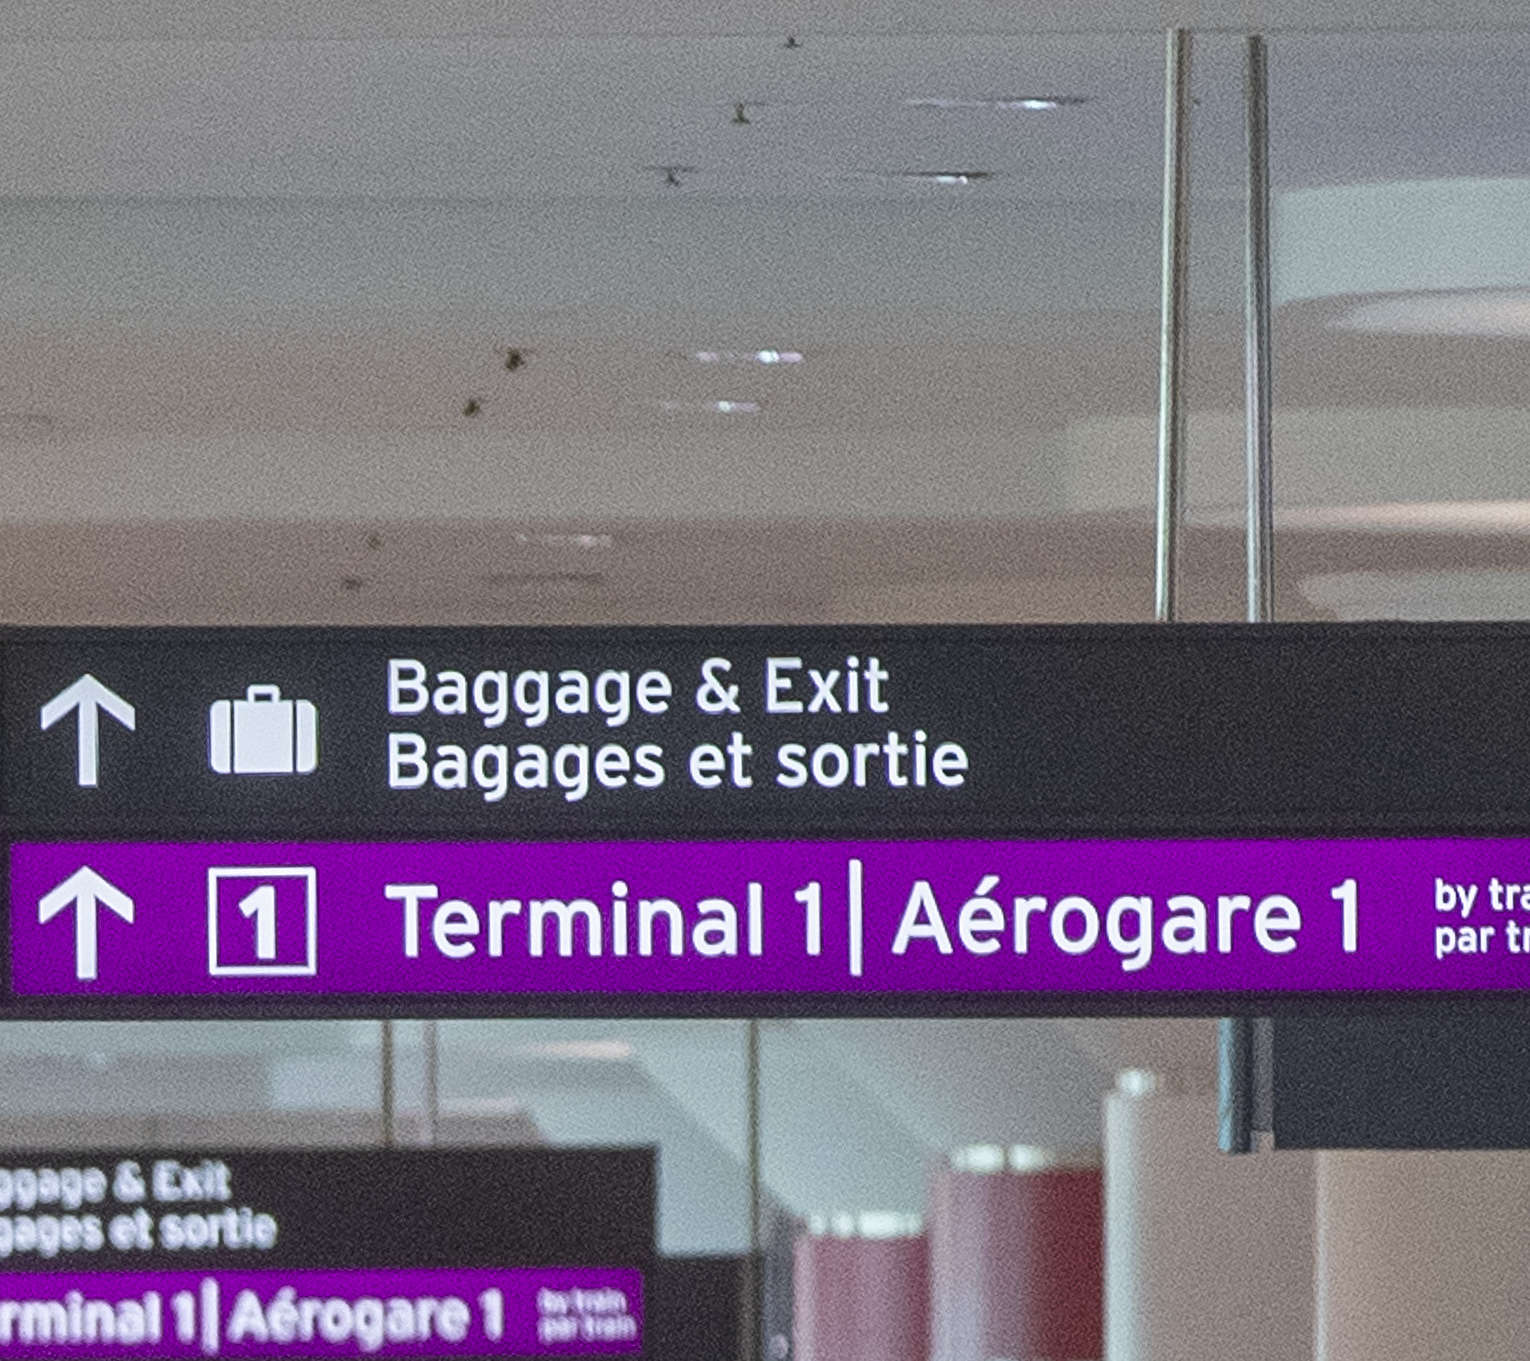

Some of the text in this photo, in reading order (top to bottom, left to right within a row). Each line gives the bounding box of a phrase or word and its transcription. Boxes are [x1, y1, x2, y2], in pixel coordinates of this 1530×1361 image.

[389, 656, 889, 727] Baggage & Exit
[389, 730, 968, 802] Bagages et sortie
[239, 885, 276, 960] 1
[385, 881, 763, 958] Terminal
[892, 873, 1301, 971] Aérogare
[1331, 879, 1357, 952] 1
[1435, 878, 1478, 918] by
[1435, 926, 1495, 959] par
[114, 1162, 146, 1200] &
[153, 1161, 230, 1200] Exit
[114, 1209, 153, 1248] et
[160, 1208, 277, 1248] sortie
[227, 1286, 468, 1351] Aérogare
[480, 1289, 503, 1339] 1
